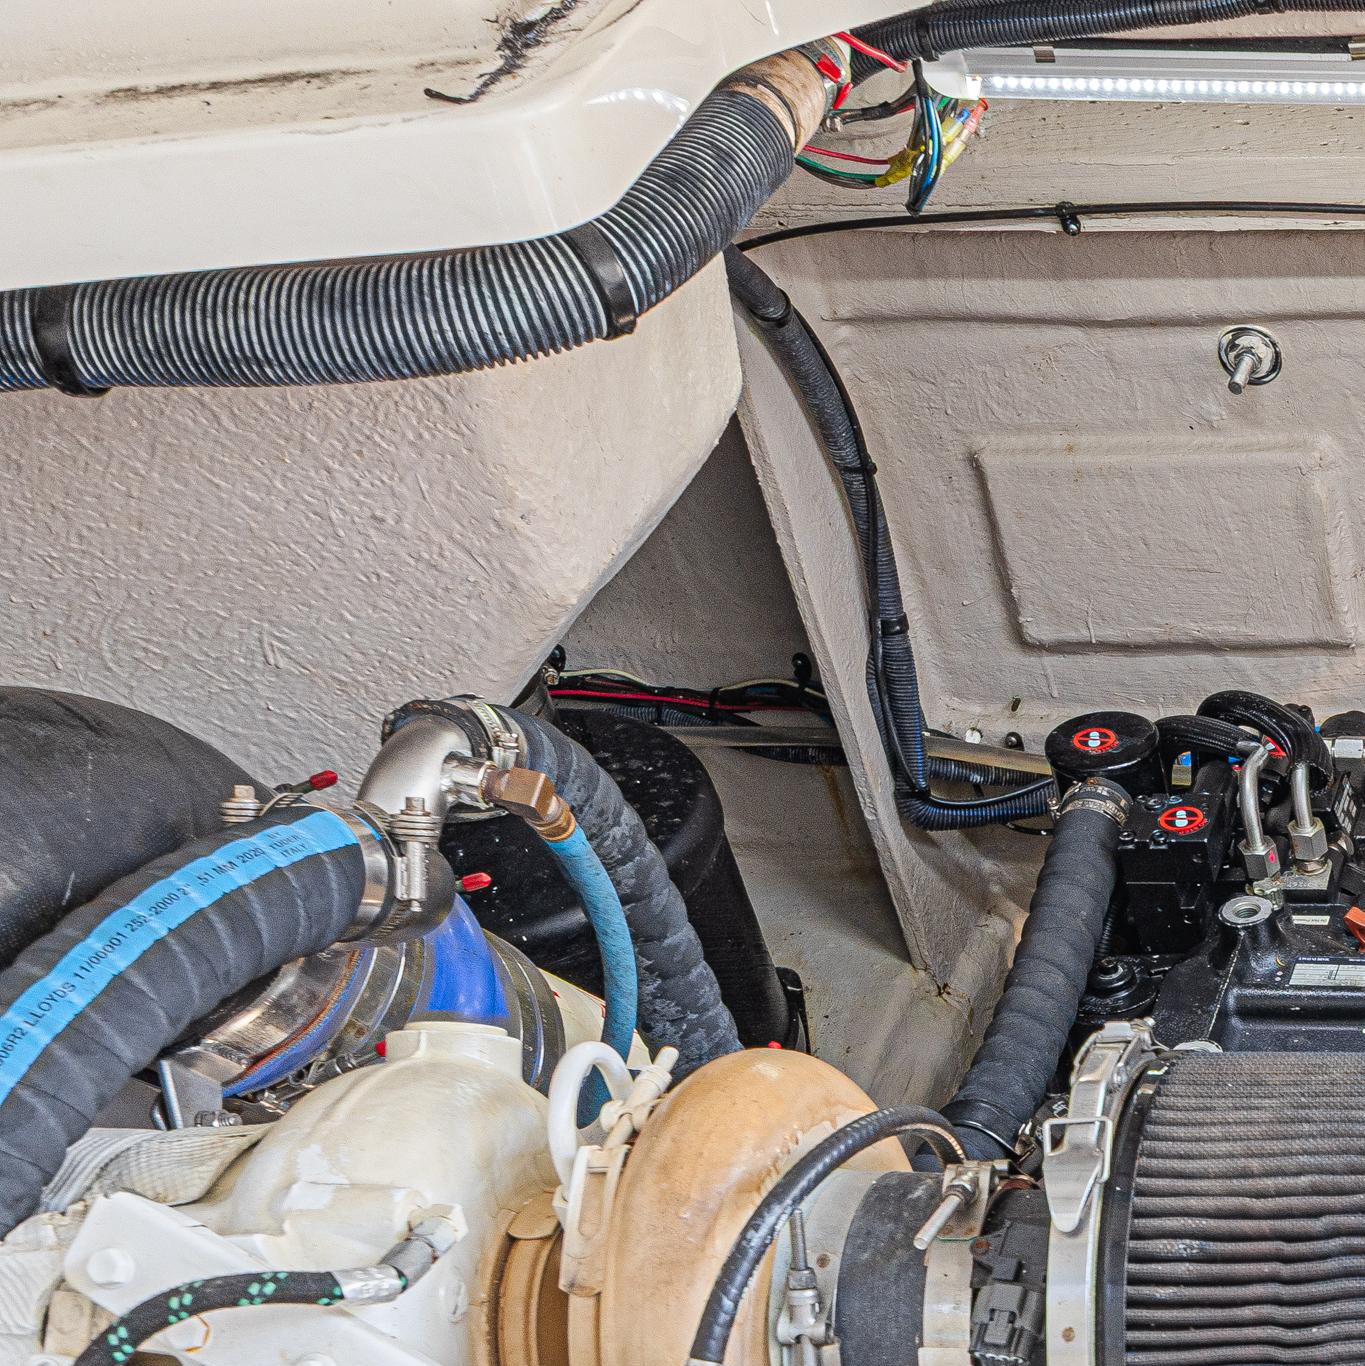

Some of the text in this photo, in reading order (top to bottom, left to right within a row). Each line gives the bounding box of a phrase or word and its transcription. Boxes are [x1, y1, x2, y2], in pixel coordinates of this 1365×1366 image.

[28, 981, 77, 1027] LLOYDS
[212, 860, 239, 882] MM
[236, 846, 265, 866] 2020
